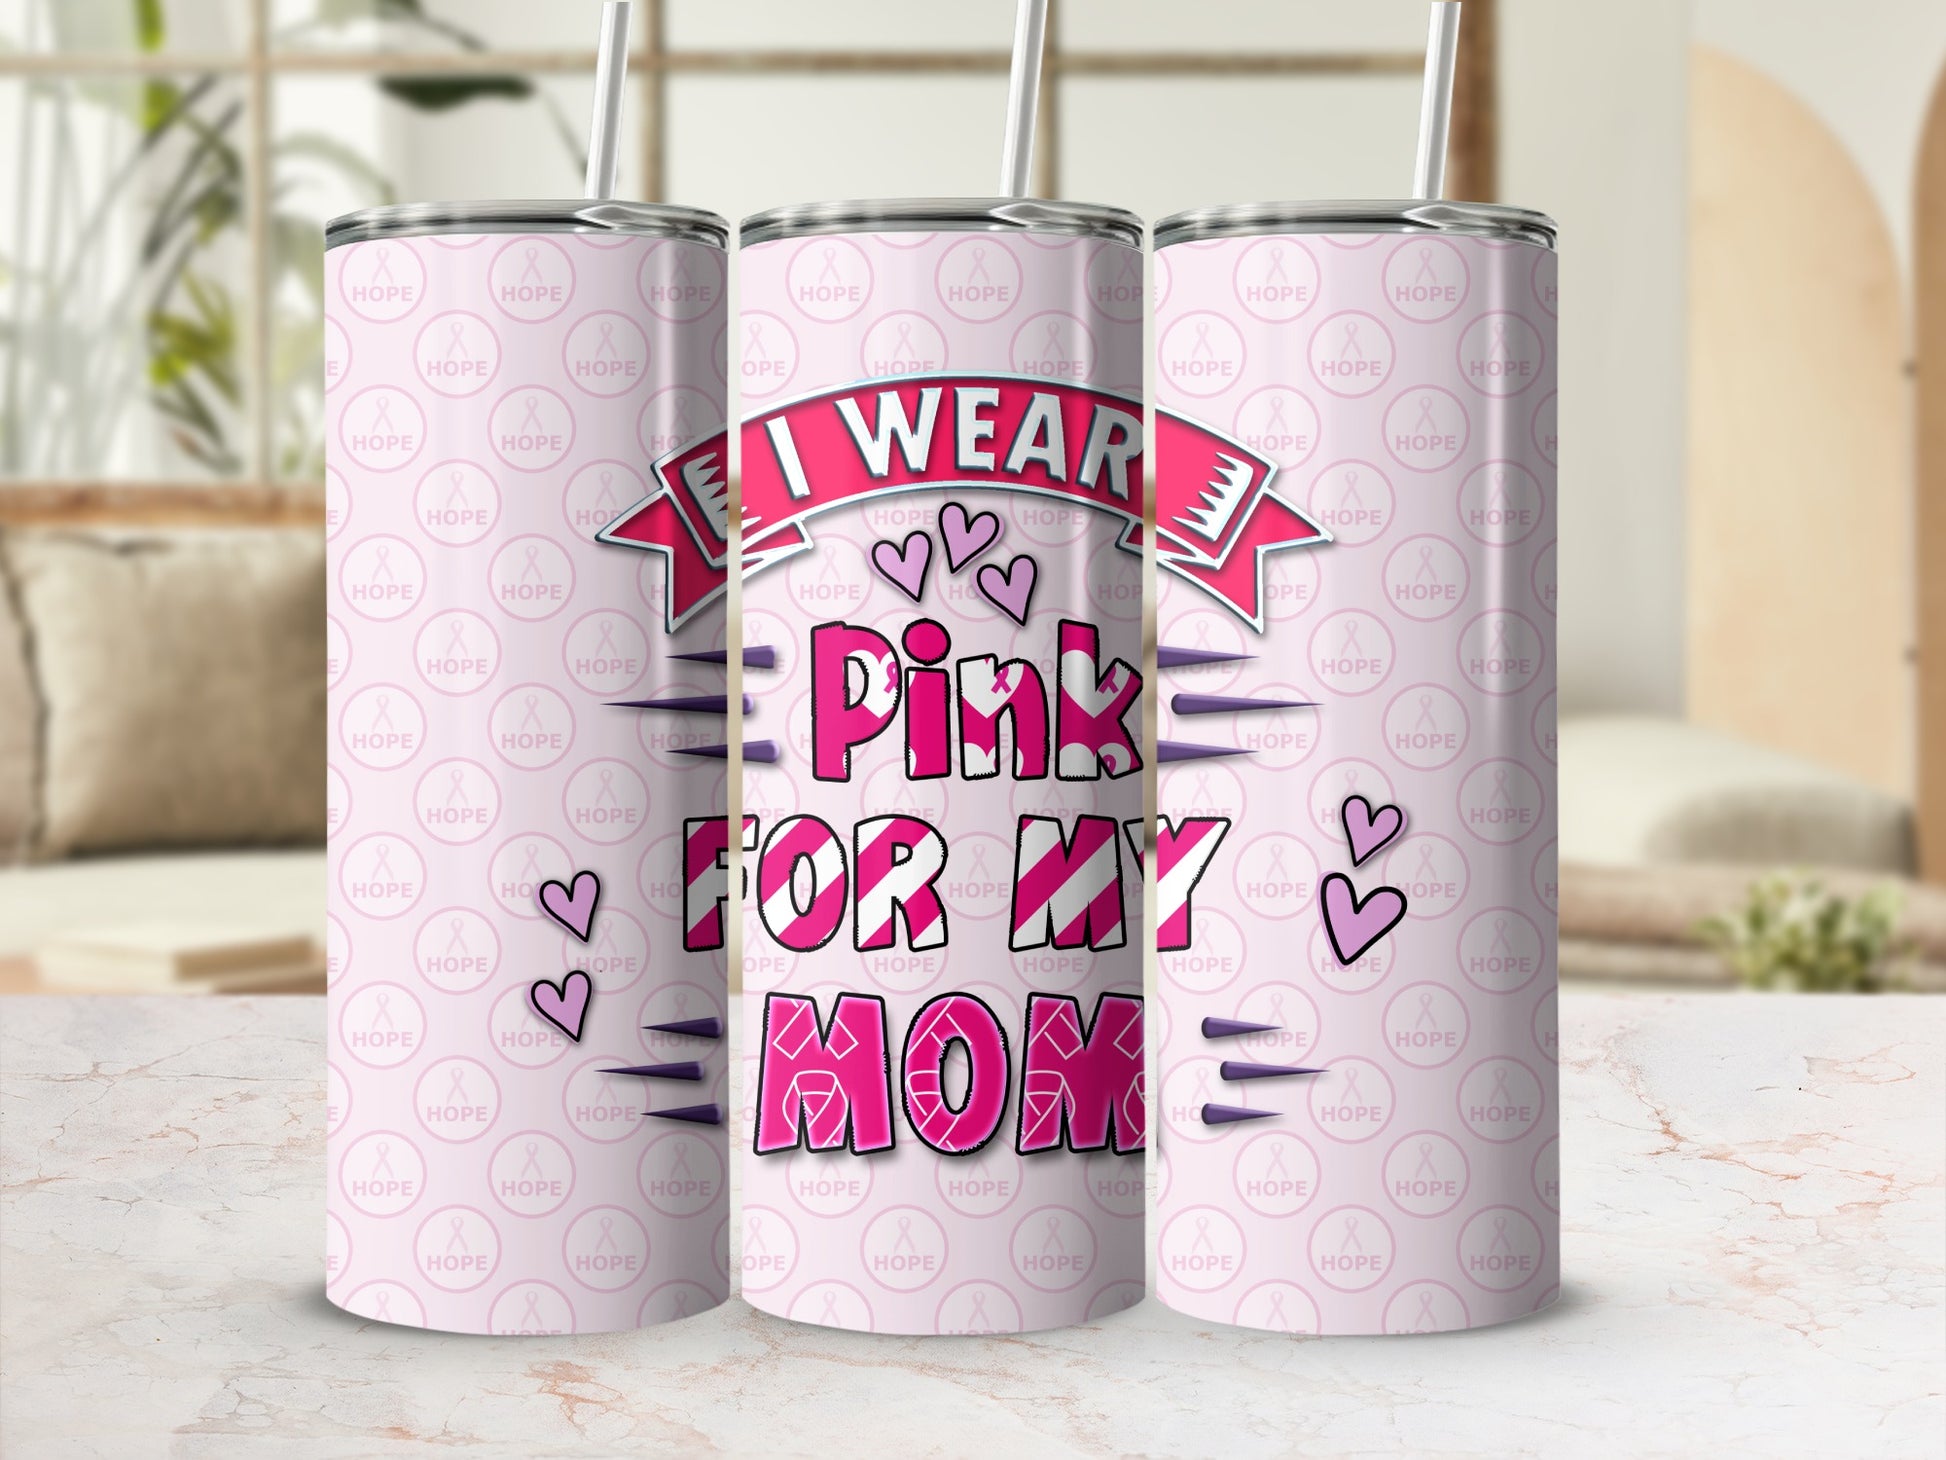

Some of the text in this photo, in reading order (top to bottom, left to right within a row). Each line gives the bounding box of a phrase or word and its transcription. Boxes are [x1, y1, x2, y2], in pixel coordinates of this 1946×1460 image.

[352, 286, 413, 303] HOPE
[501, 286, 562, 303] HOPE
[650, 286, 711, 303] HOPE
[799, 286, 860, 303] HOPE
[949, 286, 1010, 303] HOPE
[1098, 286, 1144, 303] HOP
[1246, 286, 1308, 303] HOPE
[1396, 286, 1457, 303] HOPE
[426, 361, 487, 377] HOPE
[576, 361, 636, 377] HOPE
[740, 361, 786, 377] OPE
[874, 361, 935, 376] HOPE
[1023, 361, 1084, 377] HOPE
[1172, 361, 1233, 377] HOPE
[1321, 361, 1382, 377] HOPE
[1470, 361, 1531, 377] HOPE
[352, 435, 413, 452] HOPE
[501, 435, 562, 452] HOPE
[765, 387, 1143, 501] I WEAR
[1246, 435, 1308, 452] HOPE
[1396, 435, 1457, 452] HOPE
[426, 510, 487, 526] HOPE
[874, 510, 935, 526] HOPE
[1023, 510, 1084, 526] HOPE
[1321, 510, 1382, 526] HOPE
[1470, 510, 1531, 526] HOPE
[352, 584, 413, 601] HOPE
[501, 584, 562, 601] HOPE
[799, 584, 860, 601] HOPE
[949, 584, 980, 601] HO
[1098, 584, 1144, 601] HOP
[1262, 584, 1308, 601] OPE
[1396, 584, 1457, 601] HOPE
[426, 659, 487, 676] HOPE
[576, 659, 636, 676] HOPE
[1321, 659, 1382, 676] HOPE
[1470, 659, 1531, 676] HOPE
[811, 617, 1143, 783] Pink
[352, 734, 413, 750] HOPE
[501, 734, 562, 750] HOPE
[1246, 734, 1308, 750] HOPE
[1396, 734, 1457, 750] HOPE
[426, 808, 487, 825] HOPE
[576, 808, 636, 825] HOPE
[1470, 808, 1531, 825] HOPE
[352, 883, 413, 899] HOPE
[501, 883, 532, 899] HO
[650, 883, 680, 899] HO
[949, 883, 1010, 899] HOPE
[1246, 883, 1308, 899] HOPE
[426, 957, 487, 974] HOPE
[576, 957, 636, 974] HOPE
[740, 957, 786, 974] OPE
[874, 957, 935, 974] HOPE
[1023, 957, 1084, 974] HOPE
[1172, 957, 1233, 974] HOPE
[1470, 957, 1531, 974] HOPE
[352, 1032, 413, 1048] HOPE
[501, 1032, 562, 1048] HOPE
[1246, 1032, 1308, 1048] HOPE
[1396, 1032, 1457, 1048] HOPE
[753, 992, 1144, 1156] MOM
[426, 1106, 487, 1123] HOPE
[576, 1106, 636, 1123] HOPE
[1172, 1106, 1201, 1123] HO
[1321, 1106, 1382, 1123] HOPE
[1470, 1106, 1531, 1123] HOPE
[352, 1181, 413, 1197] HOPE
[501, 1181, 562, 1197] HOPE
[650, 1181, 711, 1197] HOPE
[799, 1181, 860, 1197] HOPE
[949, 1181, 1010, 1197] HOPE
[1098, 1181, 1144, 1197] HOP
[1246, 1181, 1308, 1197] HOPE
[1396, 1181, 1457, 1197] HOPE
[426, 1255, 487, 1272] HOPE
[576, 1255, 636, 1272] HOPE
[740, 1255, 786, 1272] OPE
[874, 1255, 935, 1272] HOPE
[1023, 1255, 1084, 1272] HOPE
[1172, 1255, 1233, 1272] HOPE
[1321, 1255, 1382, 1272] HOPE
[1470, 1255, 1531, 1272] HOPE
